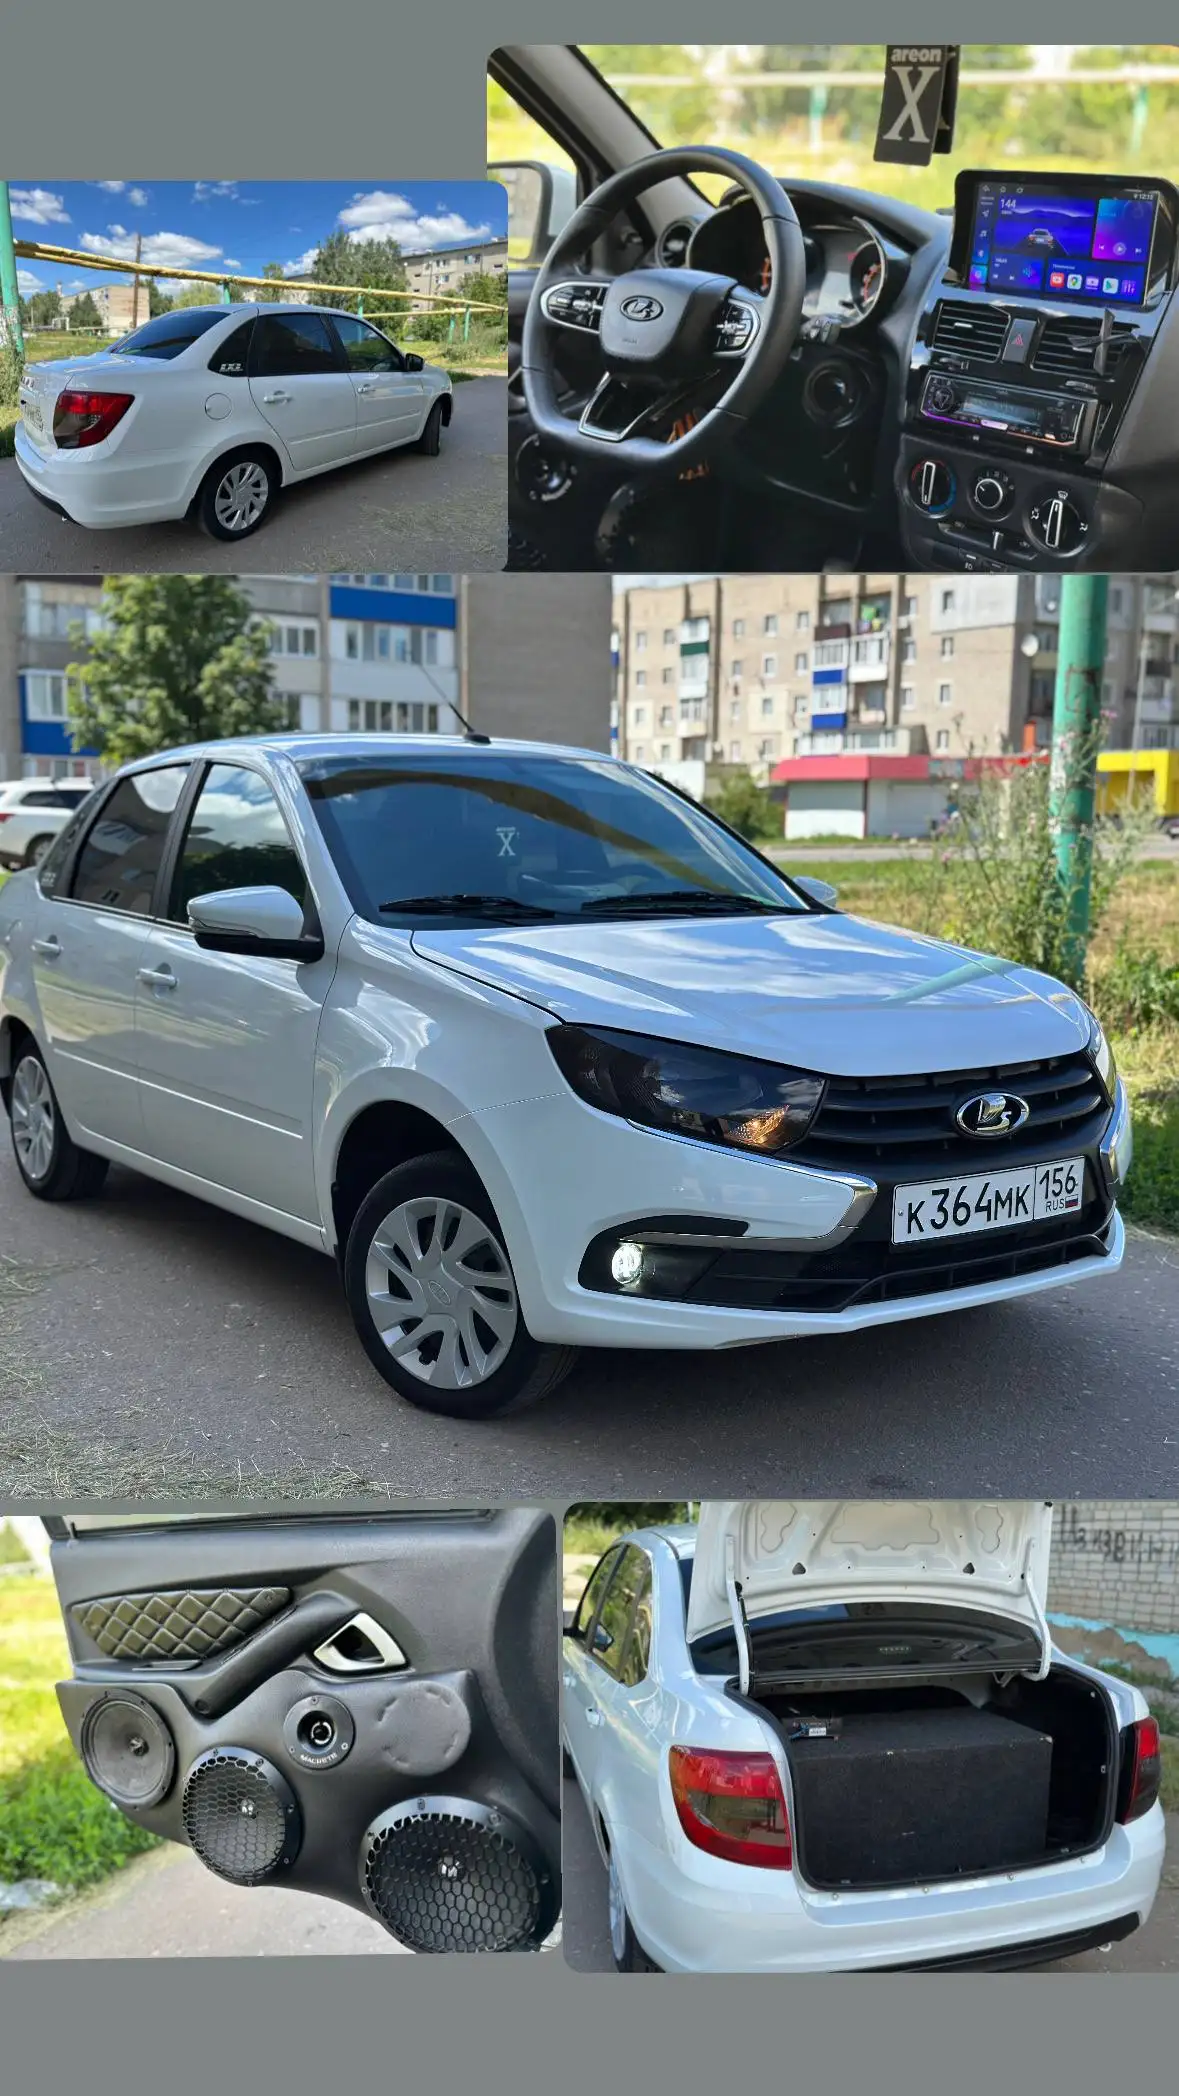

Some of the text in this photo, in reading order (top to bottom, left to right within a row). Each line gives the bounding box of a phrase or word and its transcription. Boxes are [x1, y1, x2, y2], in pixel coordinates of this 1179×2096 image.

[891, 46, 942, 63] areon
[883, 66, 941, 143] X
[1000, 198, 1017, 209] 144
[906, 1164, 1079, 1234] К364МК 156
[1045, 1197, 1065, 1213] RUS
